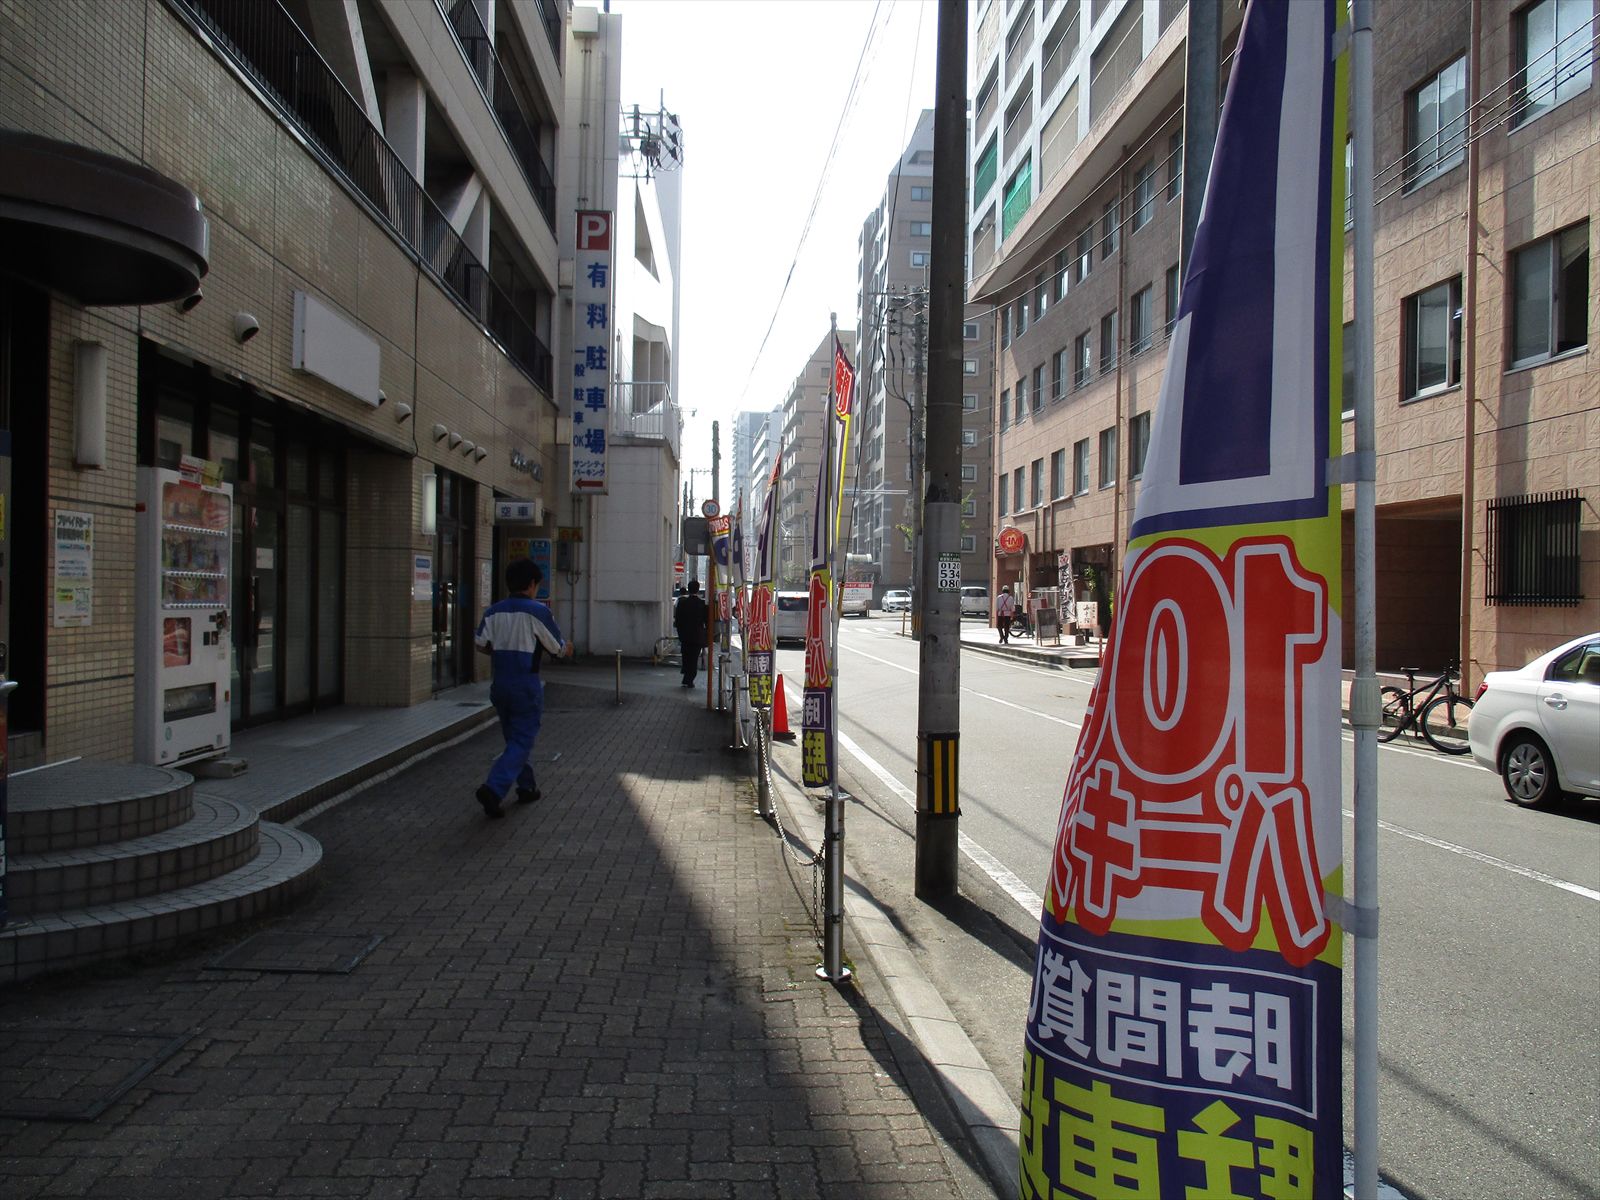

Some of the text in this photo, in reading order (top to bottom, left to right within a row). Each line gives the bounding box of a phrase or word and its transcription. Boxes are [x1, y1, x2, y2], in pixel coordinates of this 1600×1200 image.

[581, 215, 608, 249] P
[585, 262, 608, 454] 有料駐車場
[573, 460, 606, 469] サンシティ
[573, 469, 606, 477] パーキング
[501, 504, 529, 518] 空車
[706, 505, 717, 515] 30
[940, 562, 960, 570] 0120
[940, 570, 960, 579] 534
[940, 579, 960, 588] 080
